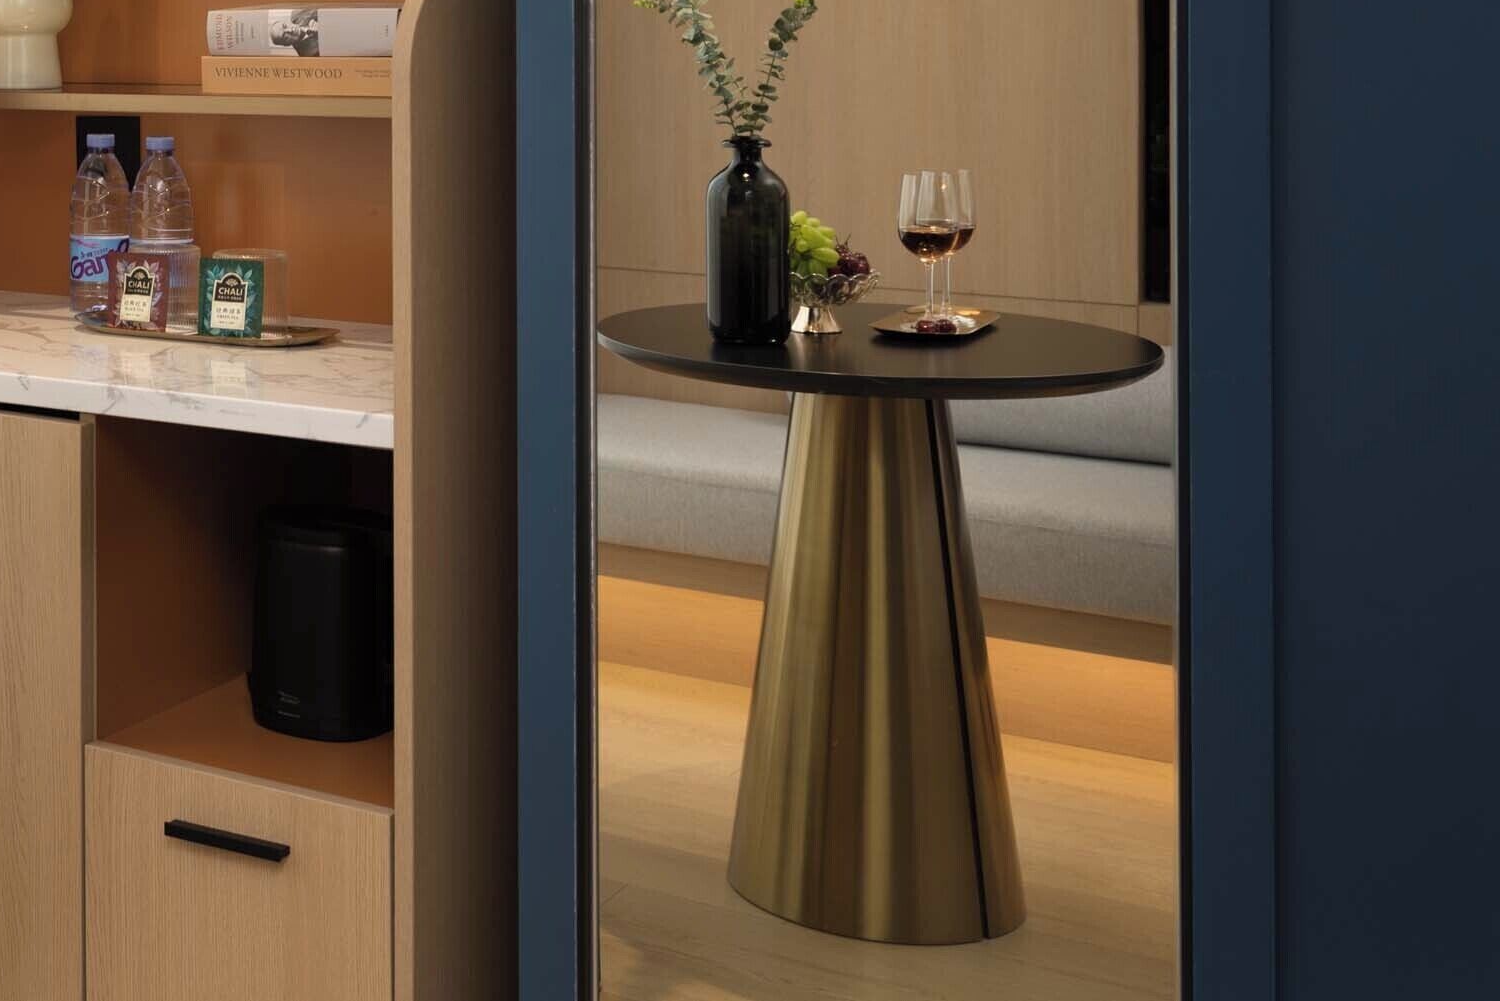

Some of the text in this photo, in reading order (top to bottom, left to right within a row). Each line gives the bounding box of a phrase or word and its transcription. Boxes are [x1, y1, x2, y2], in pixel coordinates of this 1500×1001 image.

[214, 66, 269, 79] VIVIENNE
[272, 67, 343, 80] WESTWOOD
[128, 280, 150, 289] CHALI
[218, 287, 243, 296] CHALI
